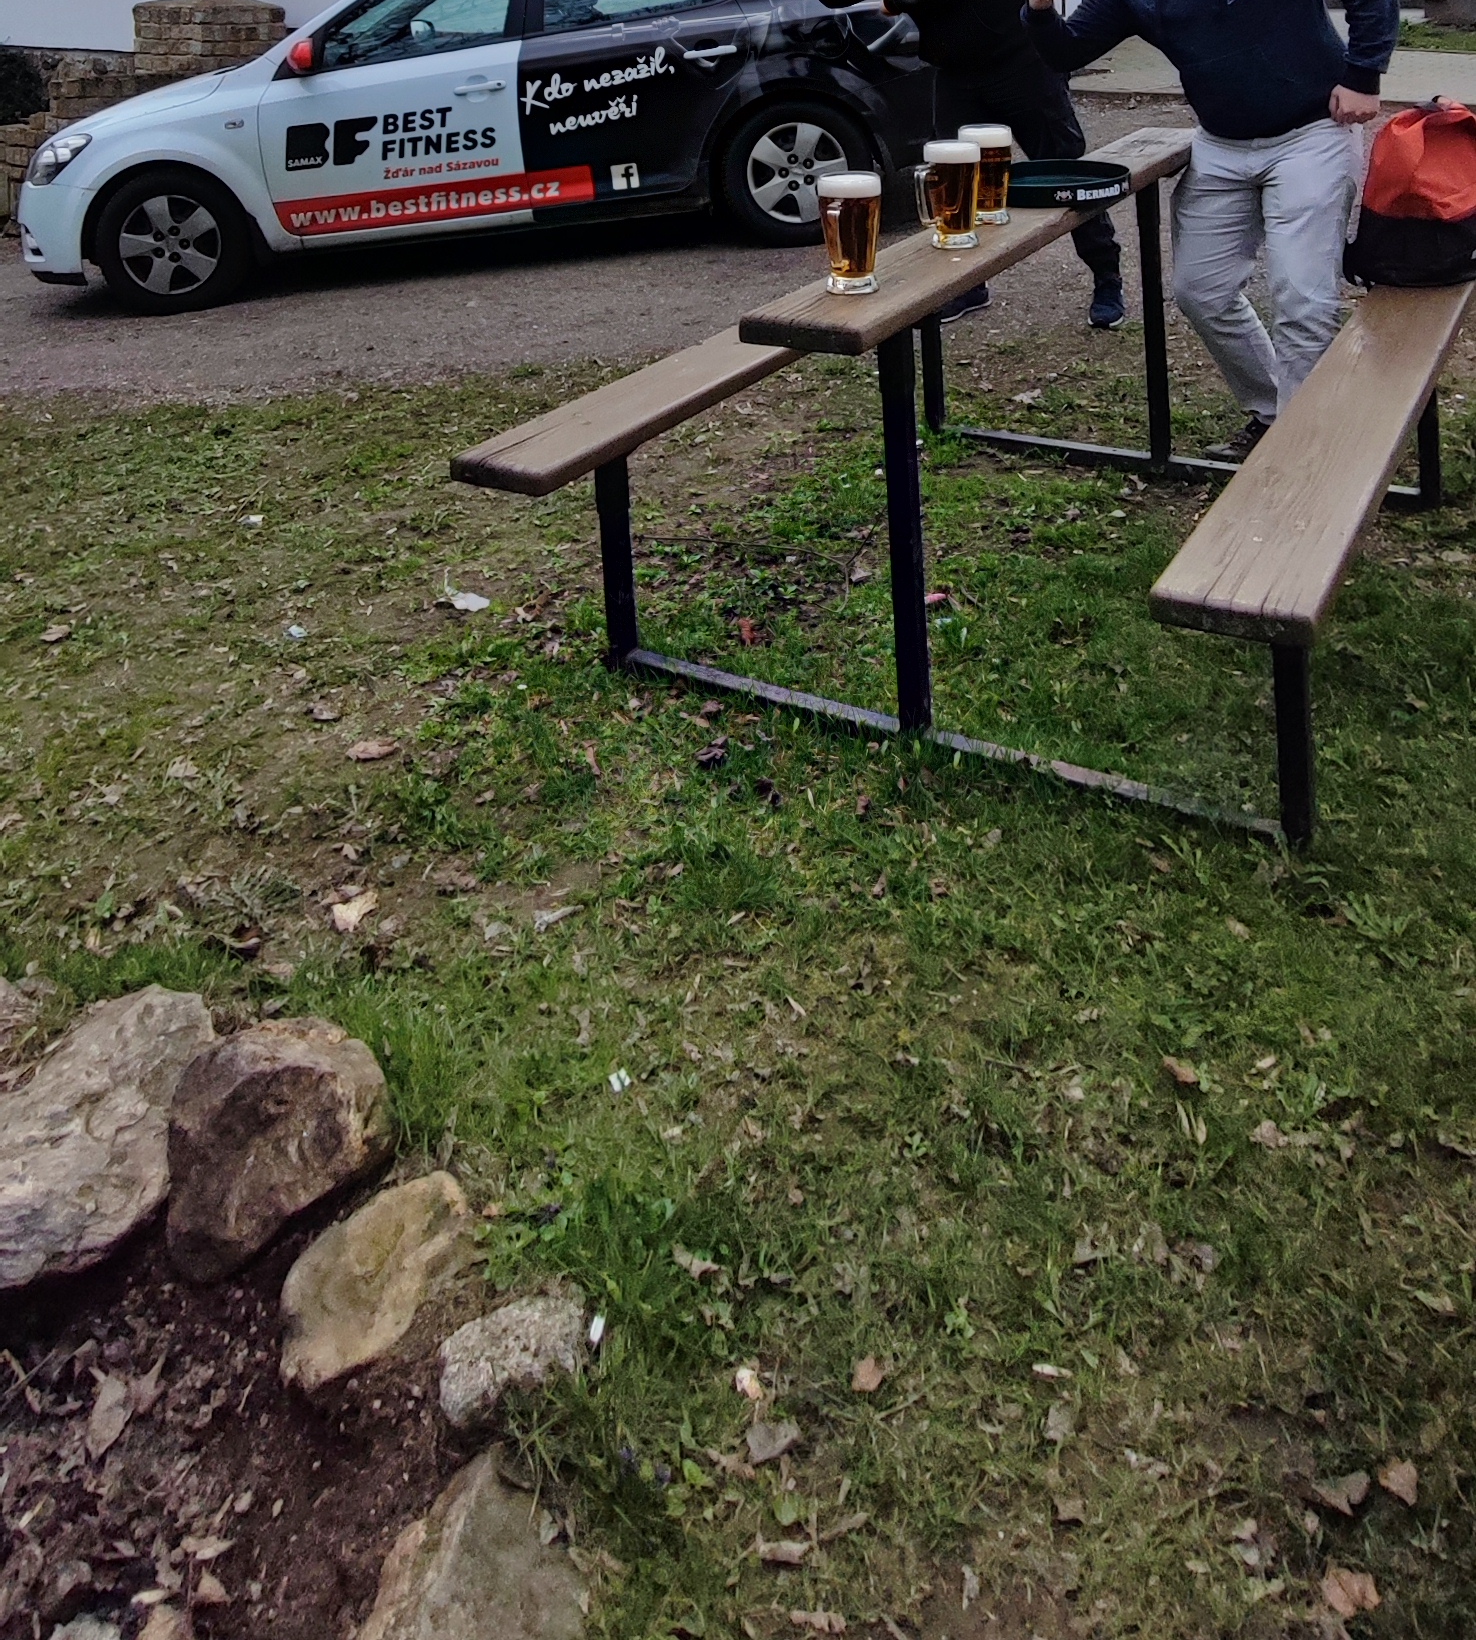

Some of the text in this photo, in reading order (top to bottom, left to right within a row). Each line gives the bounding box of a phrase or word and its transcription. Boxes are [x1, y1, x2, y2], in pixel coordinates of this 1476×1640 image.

[519, 46, 675, 116] Kdo nezažil,
[382, 106, 453, 135] BEST
[549, 94, 639, 136] neuvěří
[381, 126, 497, 161] FITNESS
[287, 155, 324, 168] SAMAX
[383, 157, 500, 180] Žďár nad Sázavou
[289, 180, 561, 229] www.bestfitness.cz
[1076, 183, 1121, 201] BERNARD
